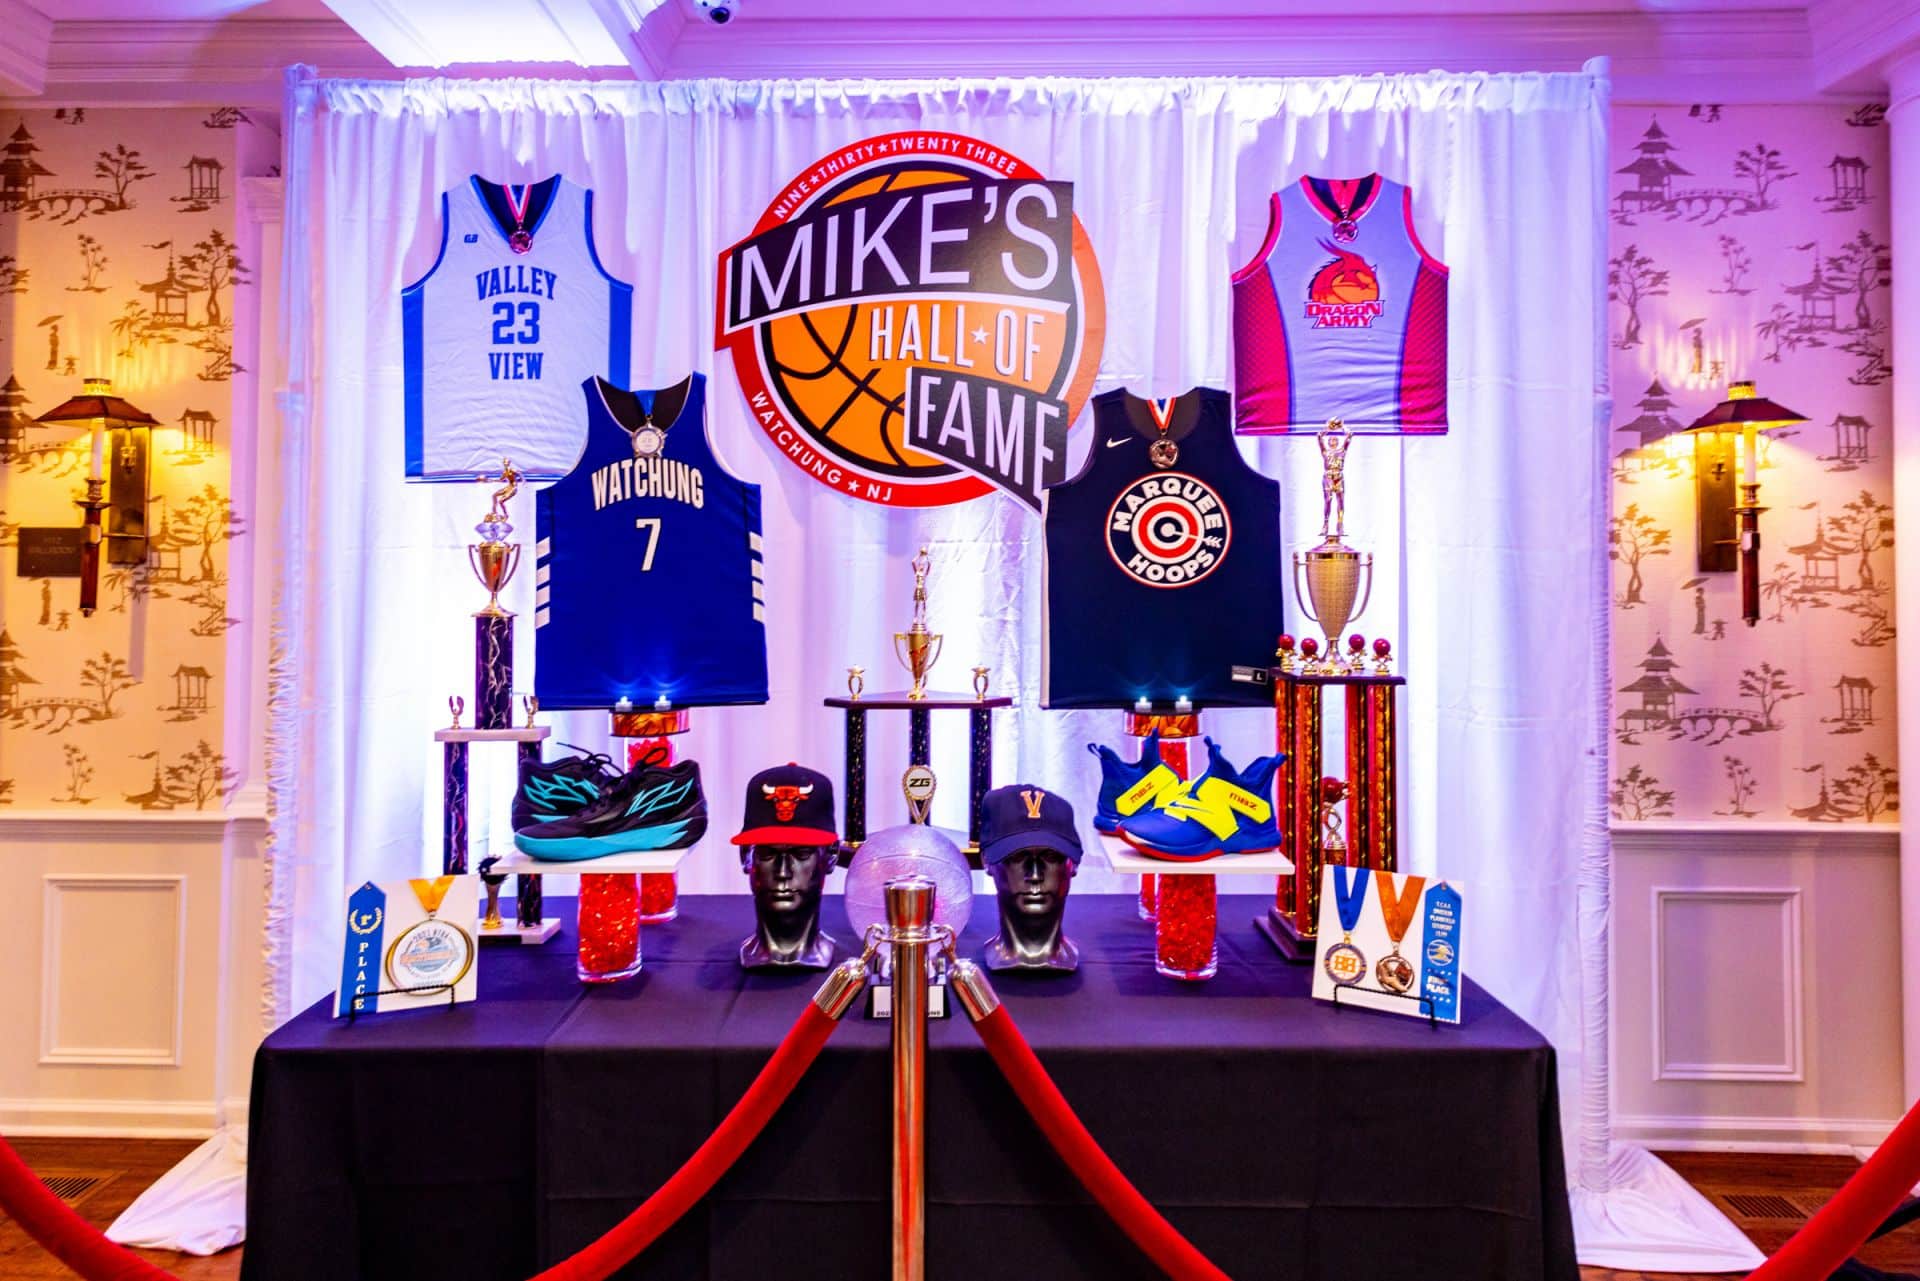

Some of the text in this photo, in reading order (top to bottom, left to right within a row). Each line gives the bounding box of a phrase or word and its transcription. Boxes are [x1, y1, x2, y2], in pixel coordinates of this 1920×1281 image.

[774, 137, 1019, 219] NINE THIRTY TWENTY THREE
[739, 183, 1059, 320] MIKE'S
[476, 265, 557, 301] VALLEY
[493, 302, 540, 345] 23
[1307, 302, 1382, 316] DRAGON
[1317, 315, 1372, 328] ARMY
[488, 352, 544, 379] VIEW
[870, 304, 1045, 381] HALL OF
[752, 391, 893, 502] WATCHUNG NJ
[918, 375, 1060, 499] FAME
[591, 457, 704, 511] WATCHUNG
[1112, 478, 1223, 532] MARQUEE
[636, 518, 661, 571] 7
[1127, 549, 1214, 582] HOOPS
[909, 778, 931, 787] ZG
[1020, 790, 1045, 818] V
